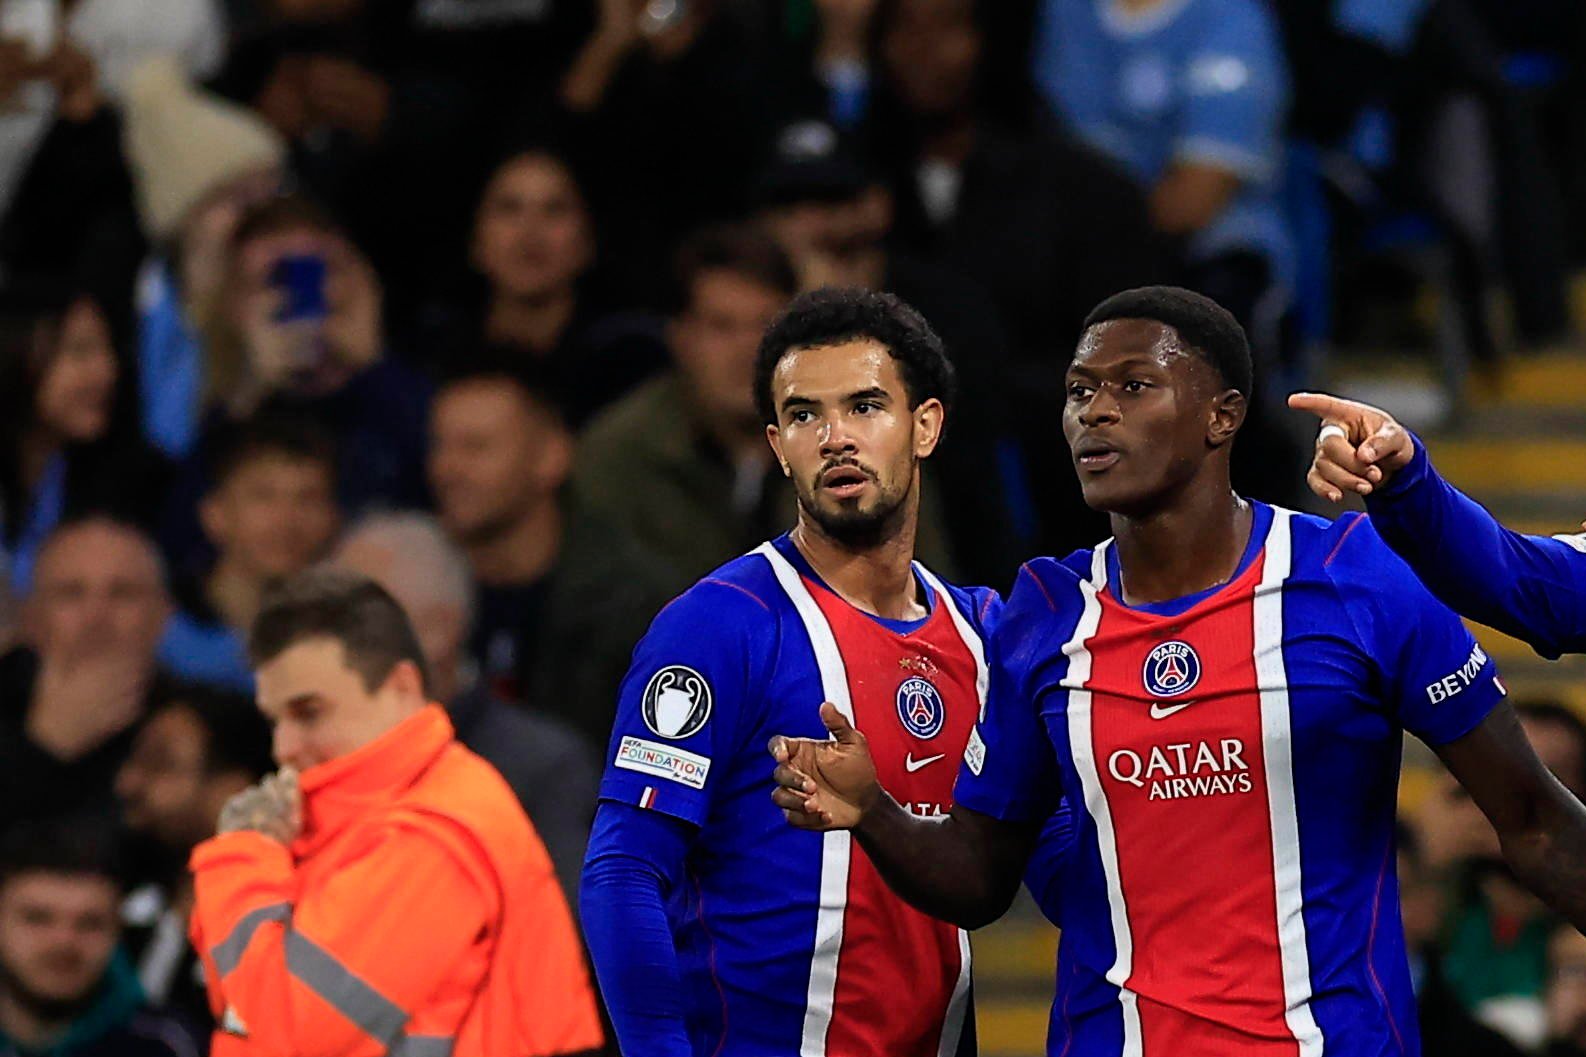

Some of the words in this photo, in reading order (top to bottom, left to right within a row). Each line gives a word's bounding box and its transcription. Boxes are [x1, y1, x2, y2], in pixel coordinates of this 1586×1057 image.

[1152, 644, 1189, 662] PARIS
[901, 681, 934, 698] PARIS
[620, 746, 706, 778] FOUNDATION
[1108, 738, 1249, 788] QATAR
[1149, 772, 1252, 801] AIRWAYS
